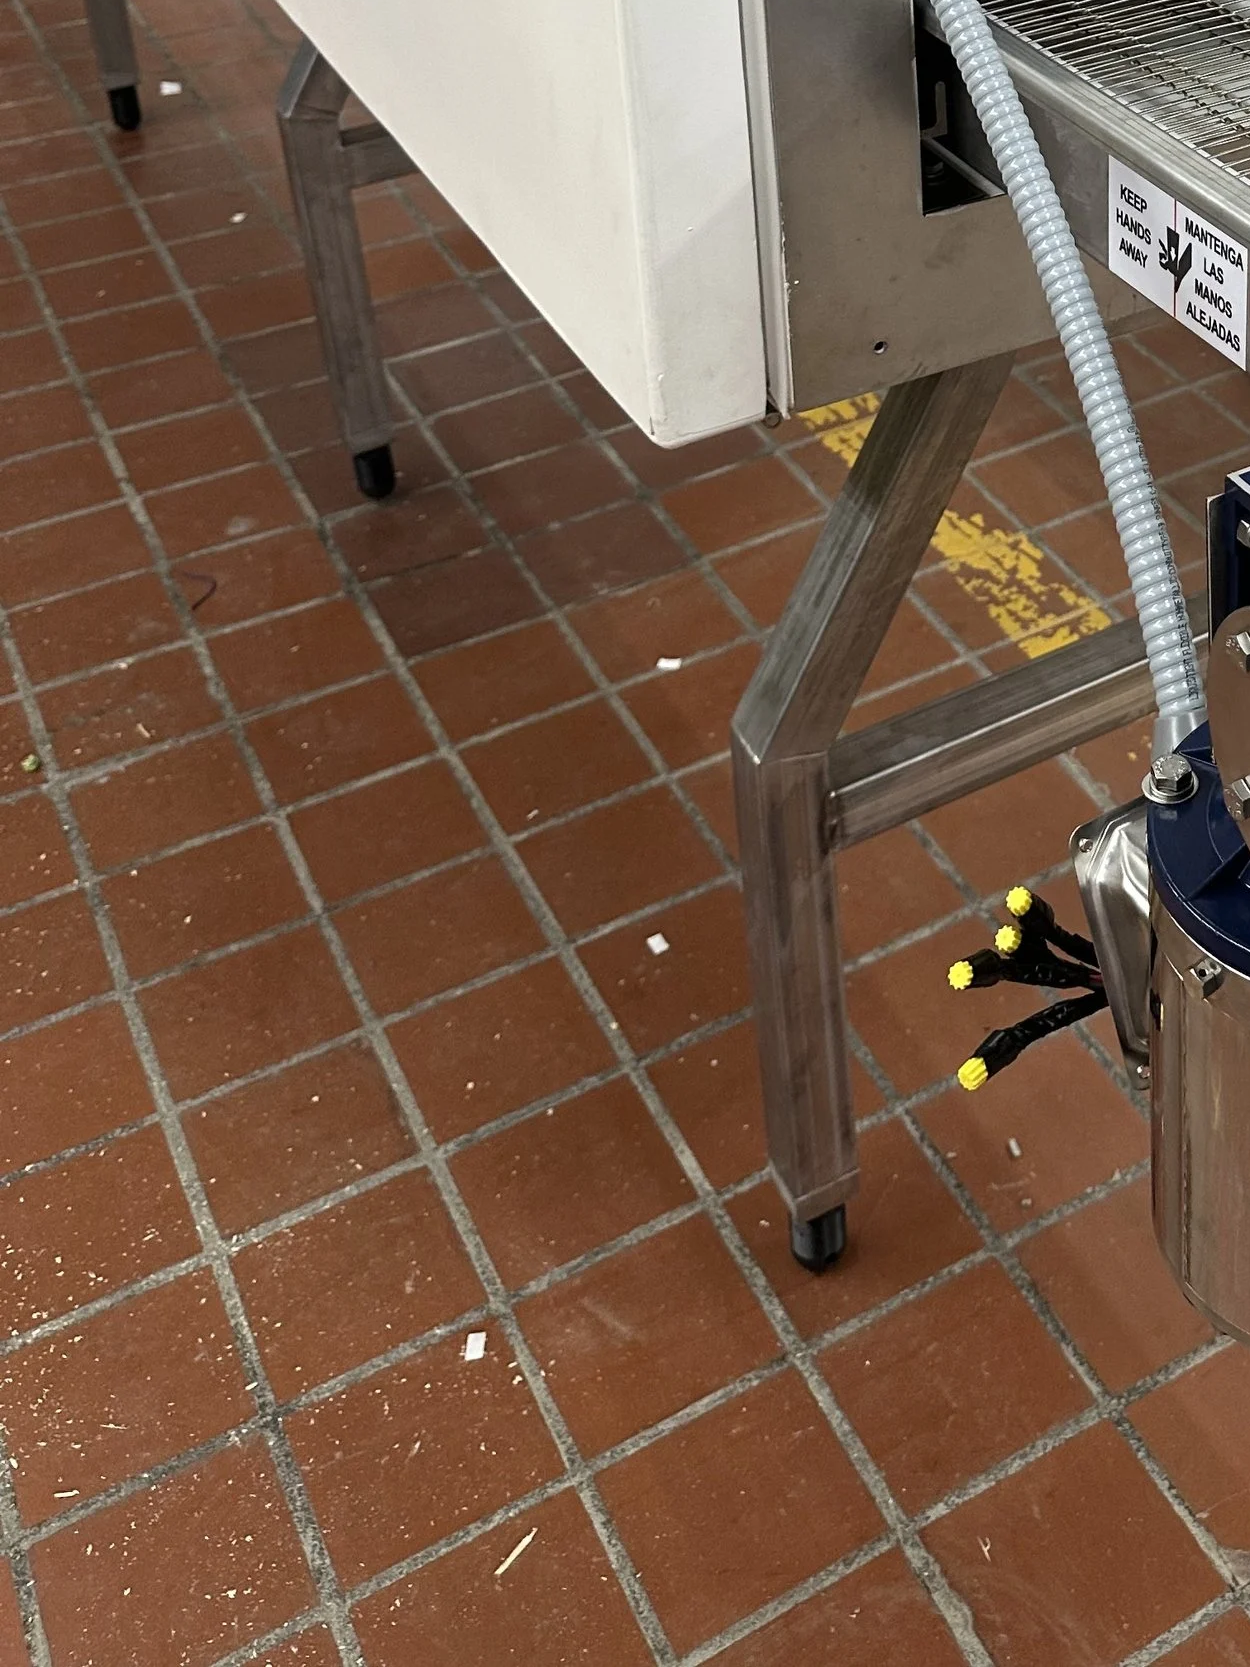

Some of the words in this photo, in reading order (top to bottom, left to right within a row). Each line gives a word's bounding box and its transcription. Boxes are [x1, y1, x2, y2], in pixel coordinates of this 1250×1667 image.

[1120, 184, 1147, 213] KEEP
[1116, 207, 1151, 245] HANDS
[1185, 217, 1244, 272] MANTENGA
[1119, 237, 1148, 269] AWAY
[1203, 257, 1224, 285] LAS
[1194, 278, 1233, 319] MANOS
[1186, 301, 1240, 352] ALEJADAS
